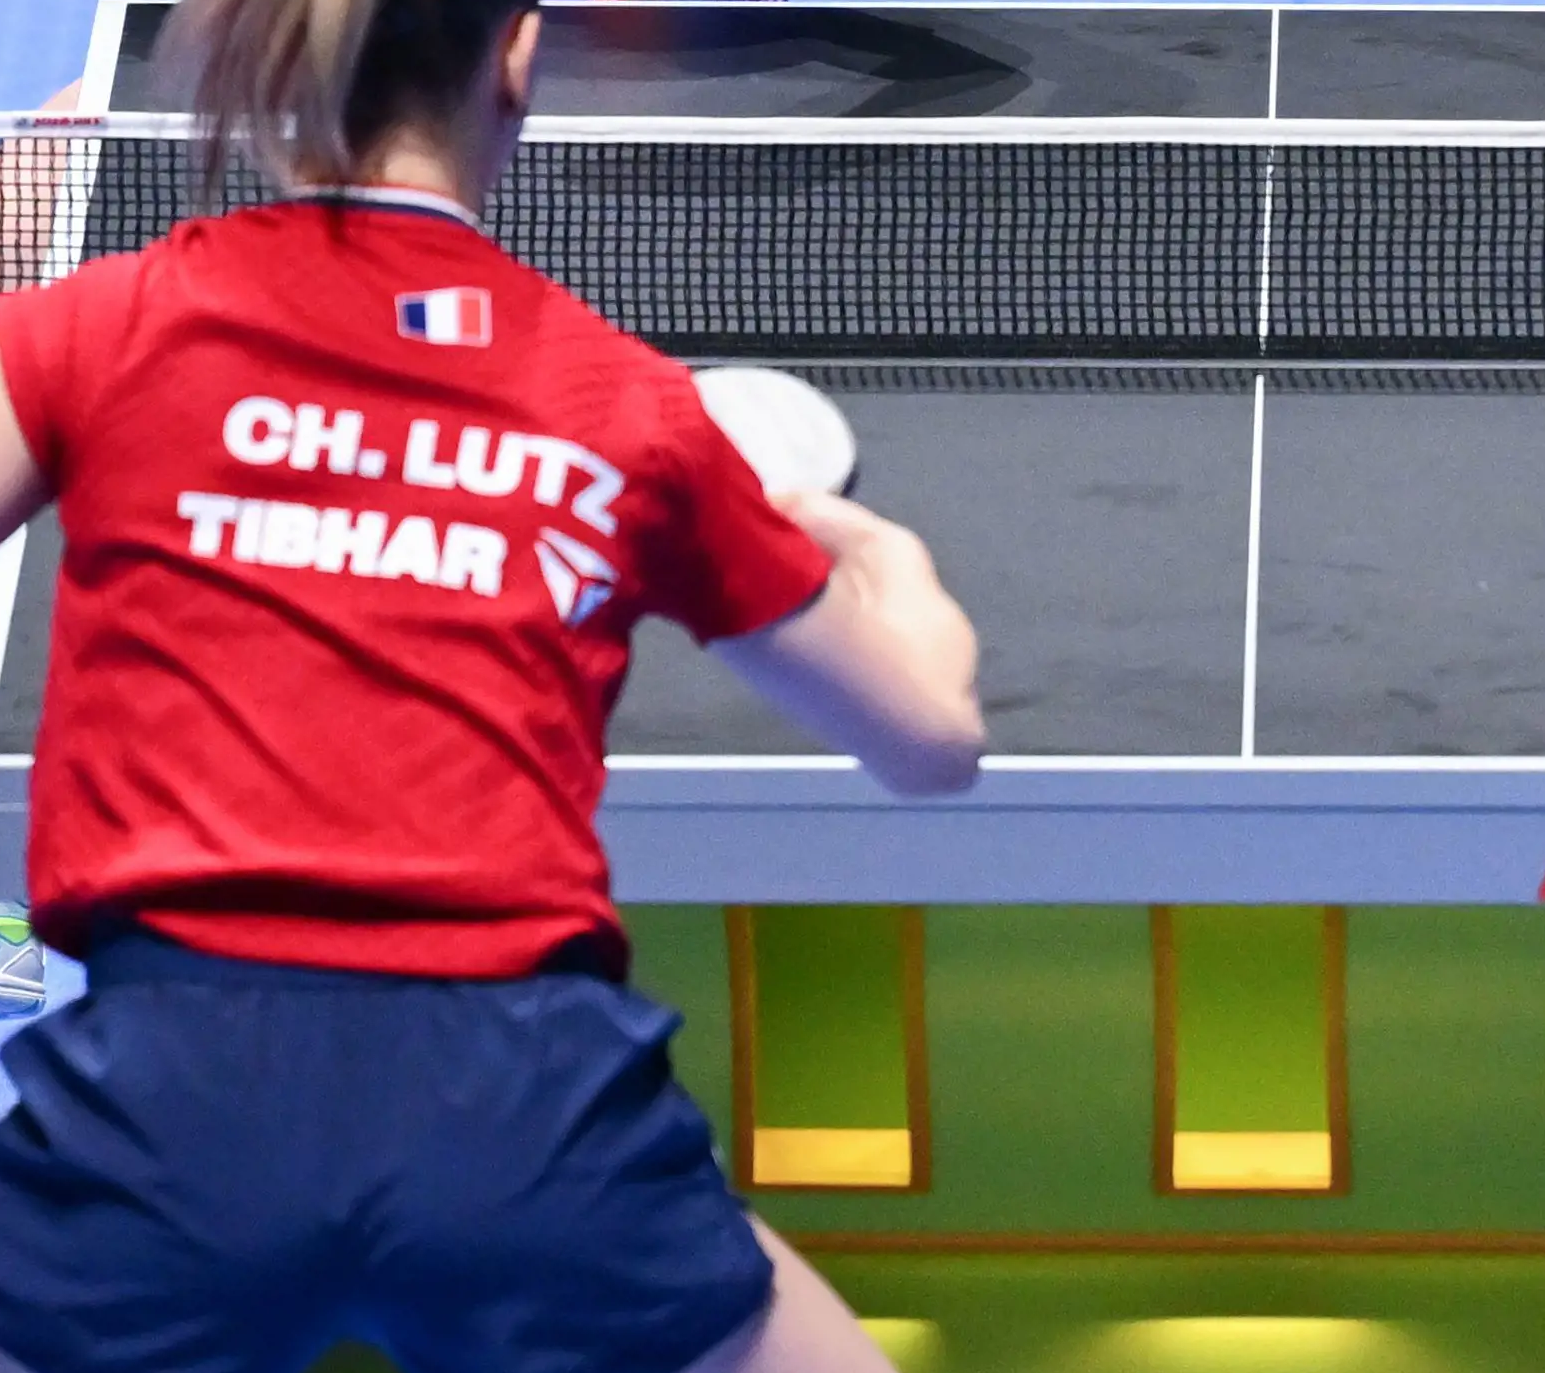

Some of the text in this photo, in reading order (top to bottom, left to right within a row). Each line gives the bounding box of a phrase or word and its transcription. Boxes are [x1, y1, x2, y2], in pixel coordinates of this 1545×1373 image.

[222, 396, 626, 537] CH. LUTZ
[176, 490, 509, 598] TIBHAR
